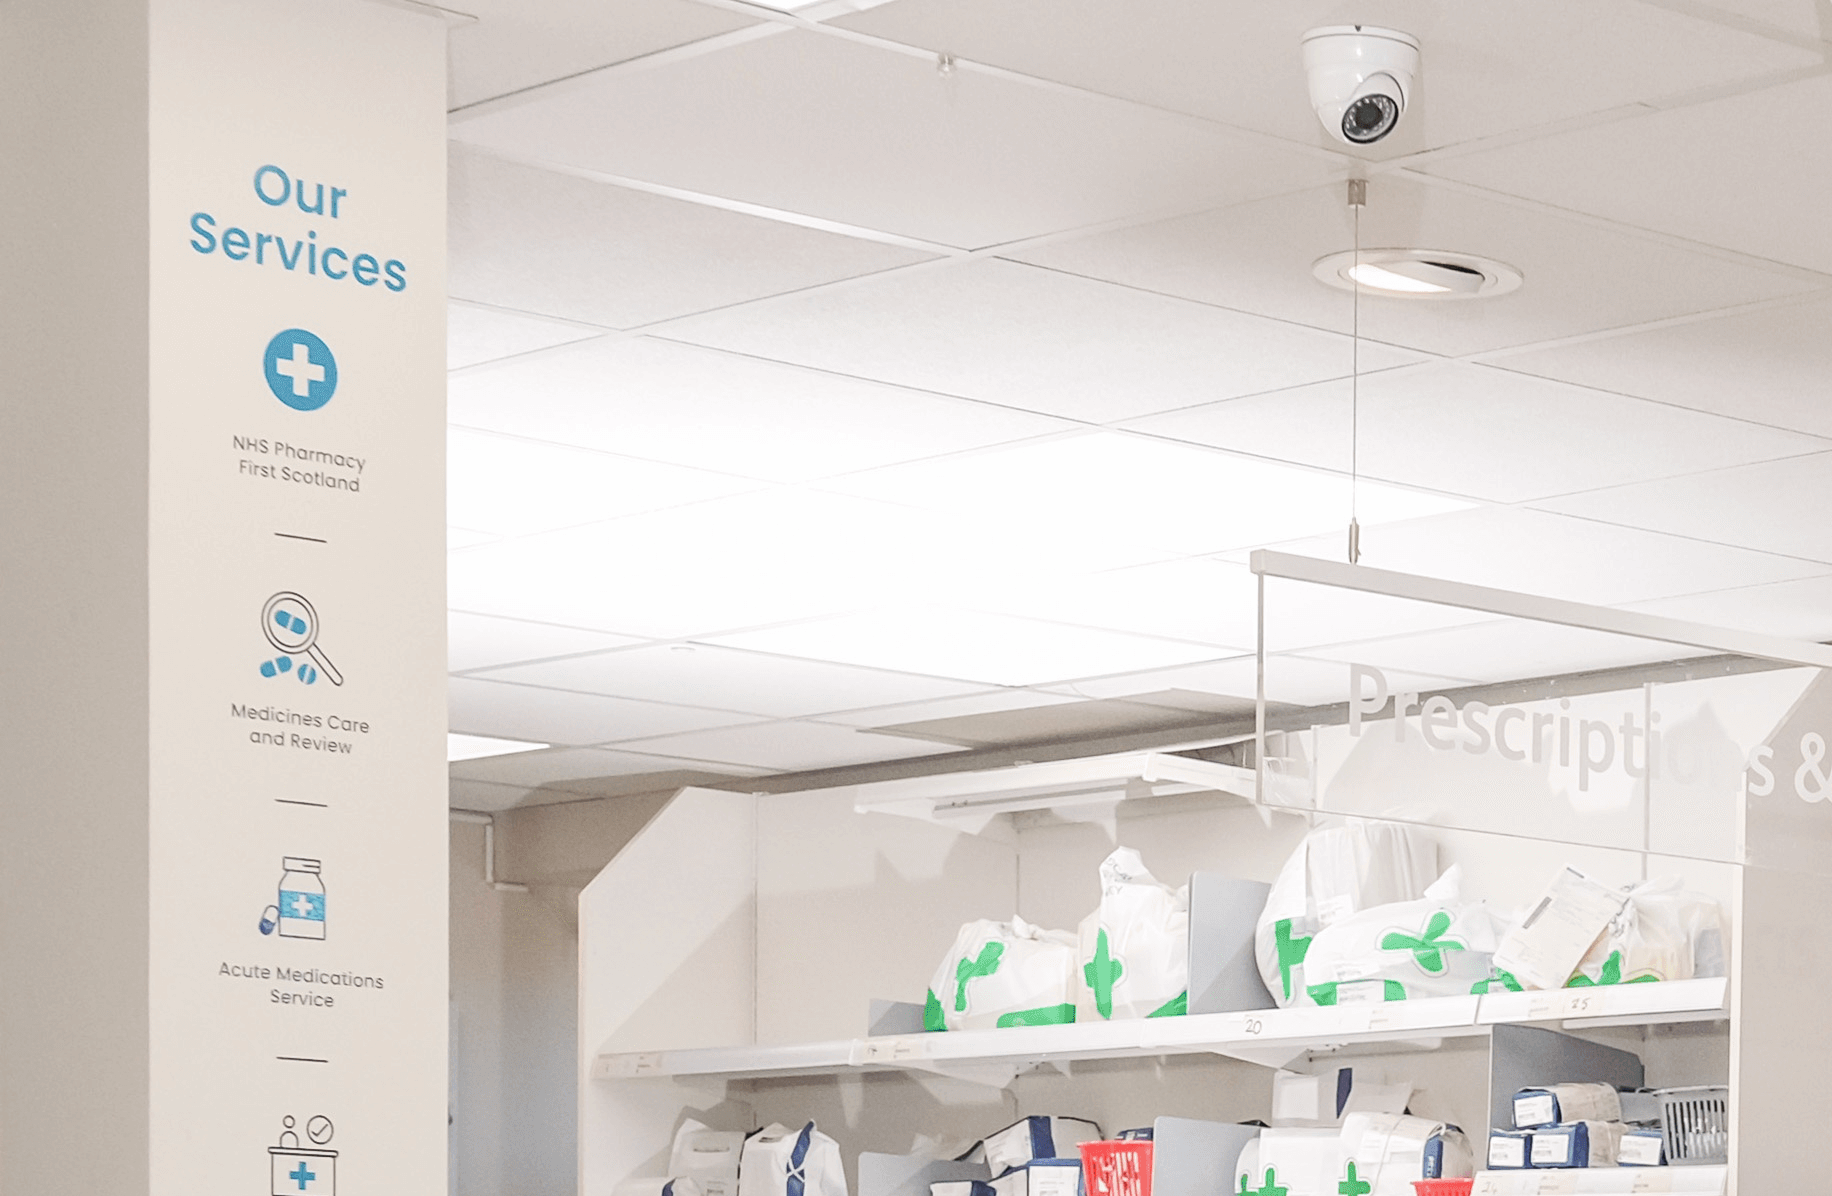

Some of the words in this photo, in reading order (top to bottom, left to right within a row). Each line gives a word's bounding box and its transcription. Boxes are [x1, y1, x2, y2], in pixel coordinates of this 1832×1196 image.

[253, 164, 347, 218] Our
[189, 211, 407, 292] Services
[232, 434, 269, 456] NHS
[274, 440, 366, 473] Pharmacy
[238, 459, 276, 479] First
[280, 465, 360, 493] Scotland
[230, 702, 322, 729] Medicines
[327, 715, 370, 735] Care
[1348, 662, 1775, 797] Prescriptis
[249, 730, 285, 748] and
[289, 733, 353, 754] Review
[219, 962, 271, 980] Acute
[276, 967, 384, 990] Medications
[270, 989, 334, 1008] Service
[1245, 1018, 1263, 1035] 20
